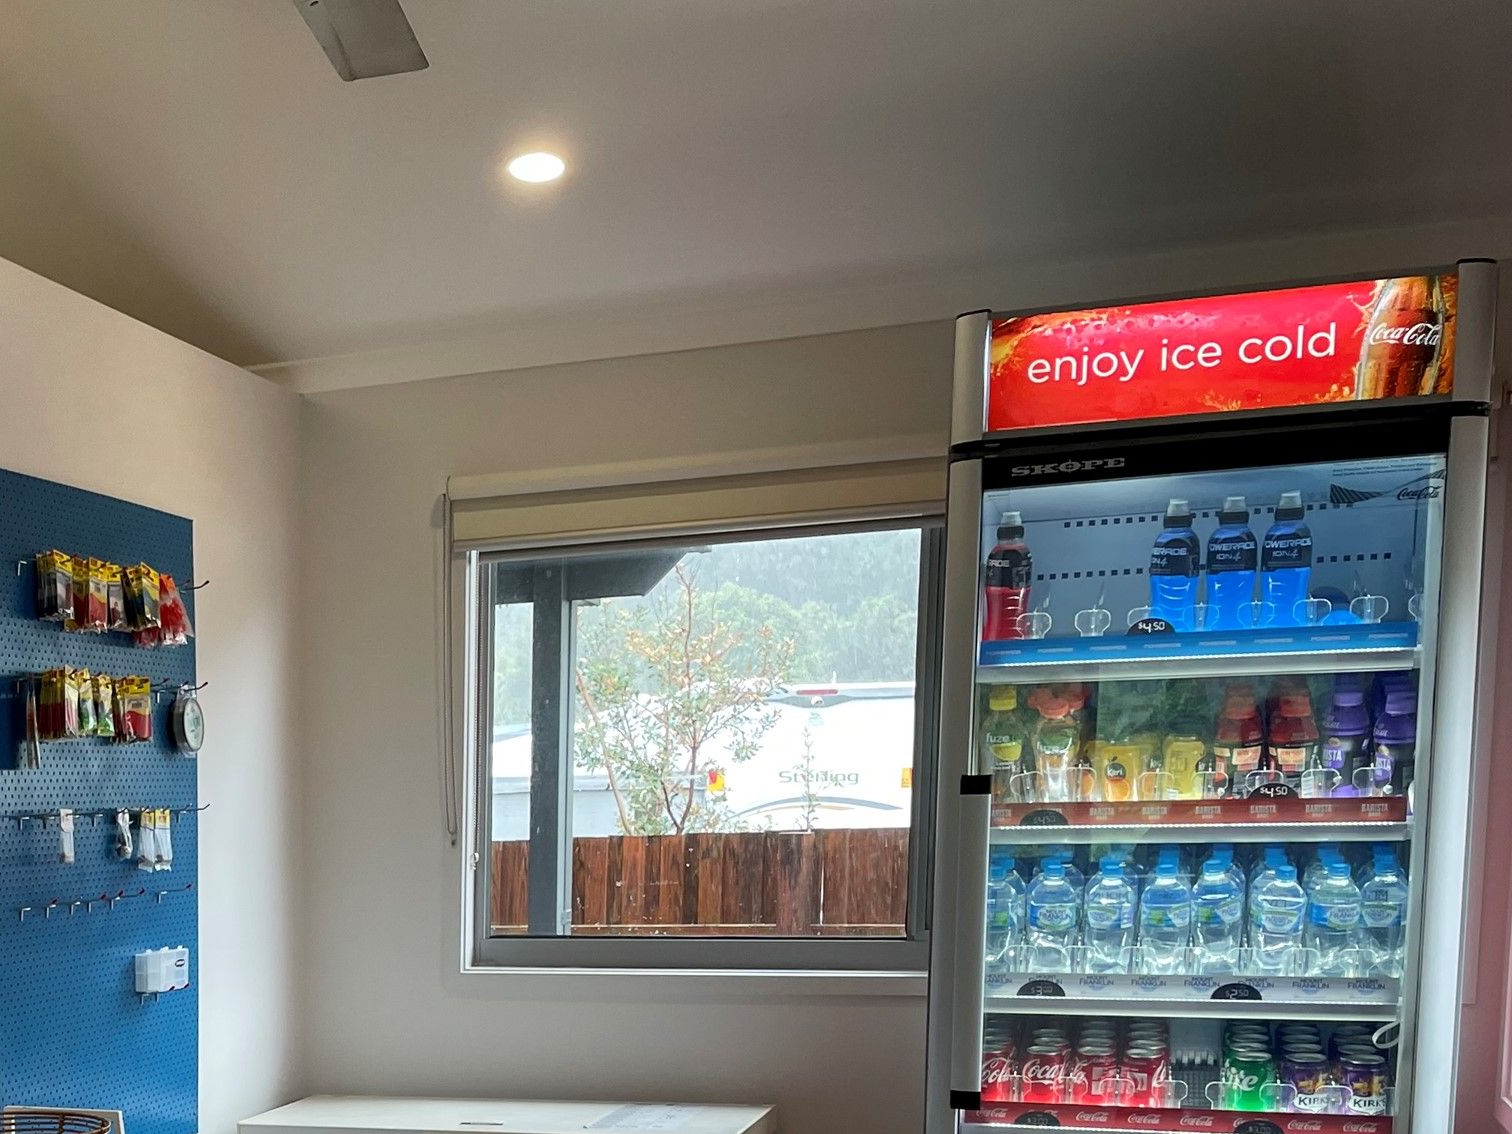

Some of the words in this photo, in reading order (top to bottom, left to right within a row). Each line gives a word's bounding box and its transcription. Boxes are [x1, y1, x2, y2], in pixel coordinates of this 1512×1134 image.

[1369, 321, 1441, 347] Coca-Cola
[1027, 346, 1145, 386] enjoy
[1160, 339, 1223, 373] ice
[1237, 322, 1338, 365] cold
[1010, 457, 1126, 478] SKOPE
[1397, 485, 1442, 500] Coca-Cola
[986, 733, 1010, 743] fuze
[1038, 742, 1060, 751] fuze
[778, 770, 859, 785] Sterling
[1195, 806, 1221, 815] BARISTA
[1250, 805, 1276, 814] BARISTA
[1306, 804, 1332, 813] BARISTA
[1362, 803, 1388, 812] BARISTA
[1041, 911, 1071, 921] FRANKLIN
[1131, 979, 1167, 987] FRANKLIN
[1076, 1112, 1109, 1122] Coca-Cola
[1128, 1114, 1161, 1124] Coca-Cola
[1180, 1115, 1215, 1127] Coca-Cola
[1288, 1120, 1323, 1131] Coca-Cola
[1343, 1122, 1378, 1133] Coca-Cola
